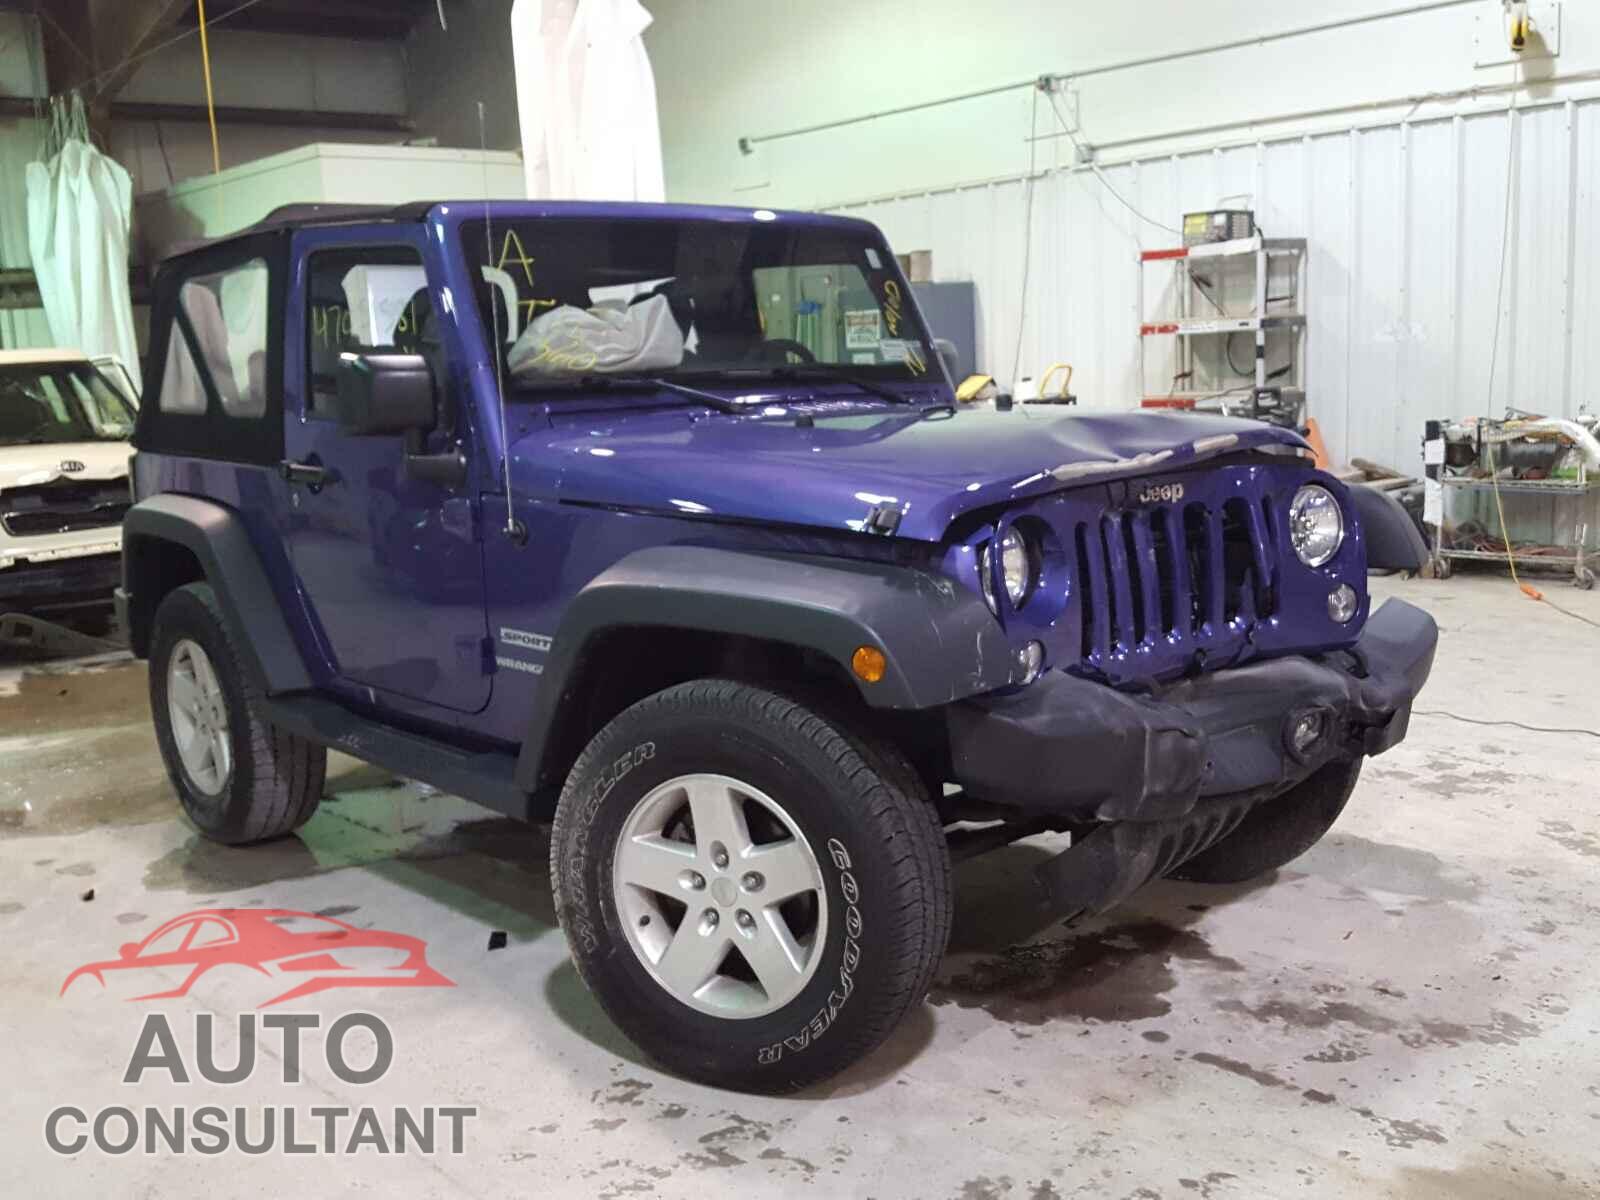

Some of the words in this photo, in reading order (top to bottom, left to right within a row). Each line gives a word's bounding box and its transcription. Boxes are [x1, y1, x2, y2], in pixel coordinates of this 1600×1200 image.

[1139, 483, 1184, 503] Jeep
[502, 629, 552, 650] SPORT
[758, 838, 862, 1065] GOODYEAR
